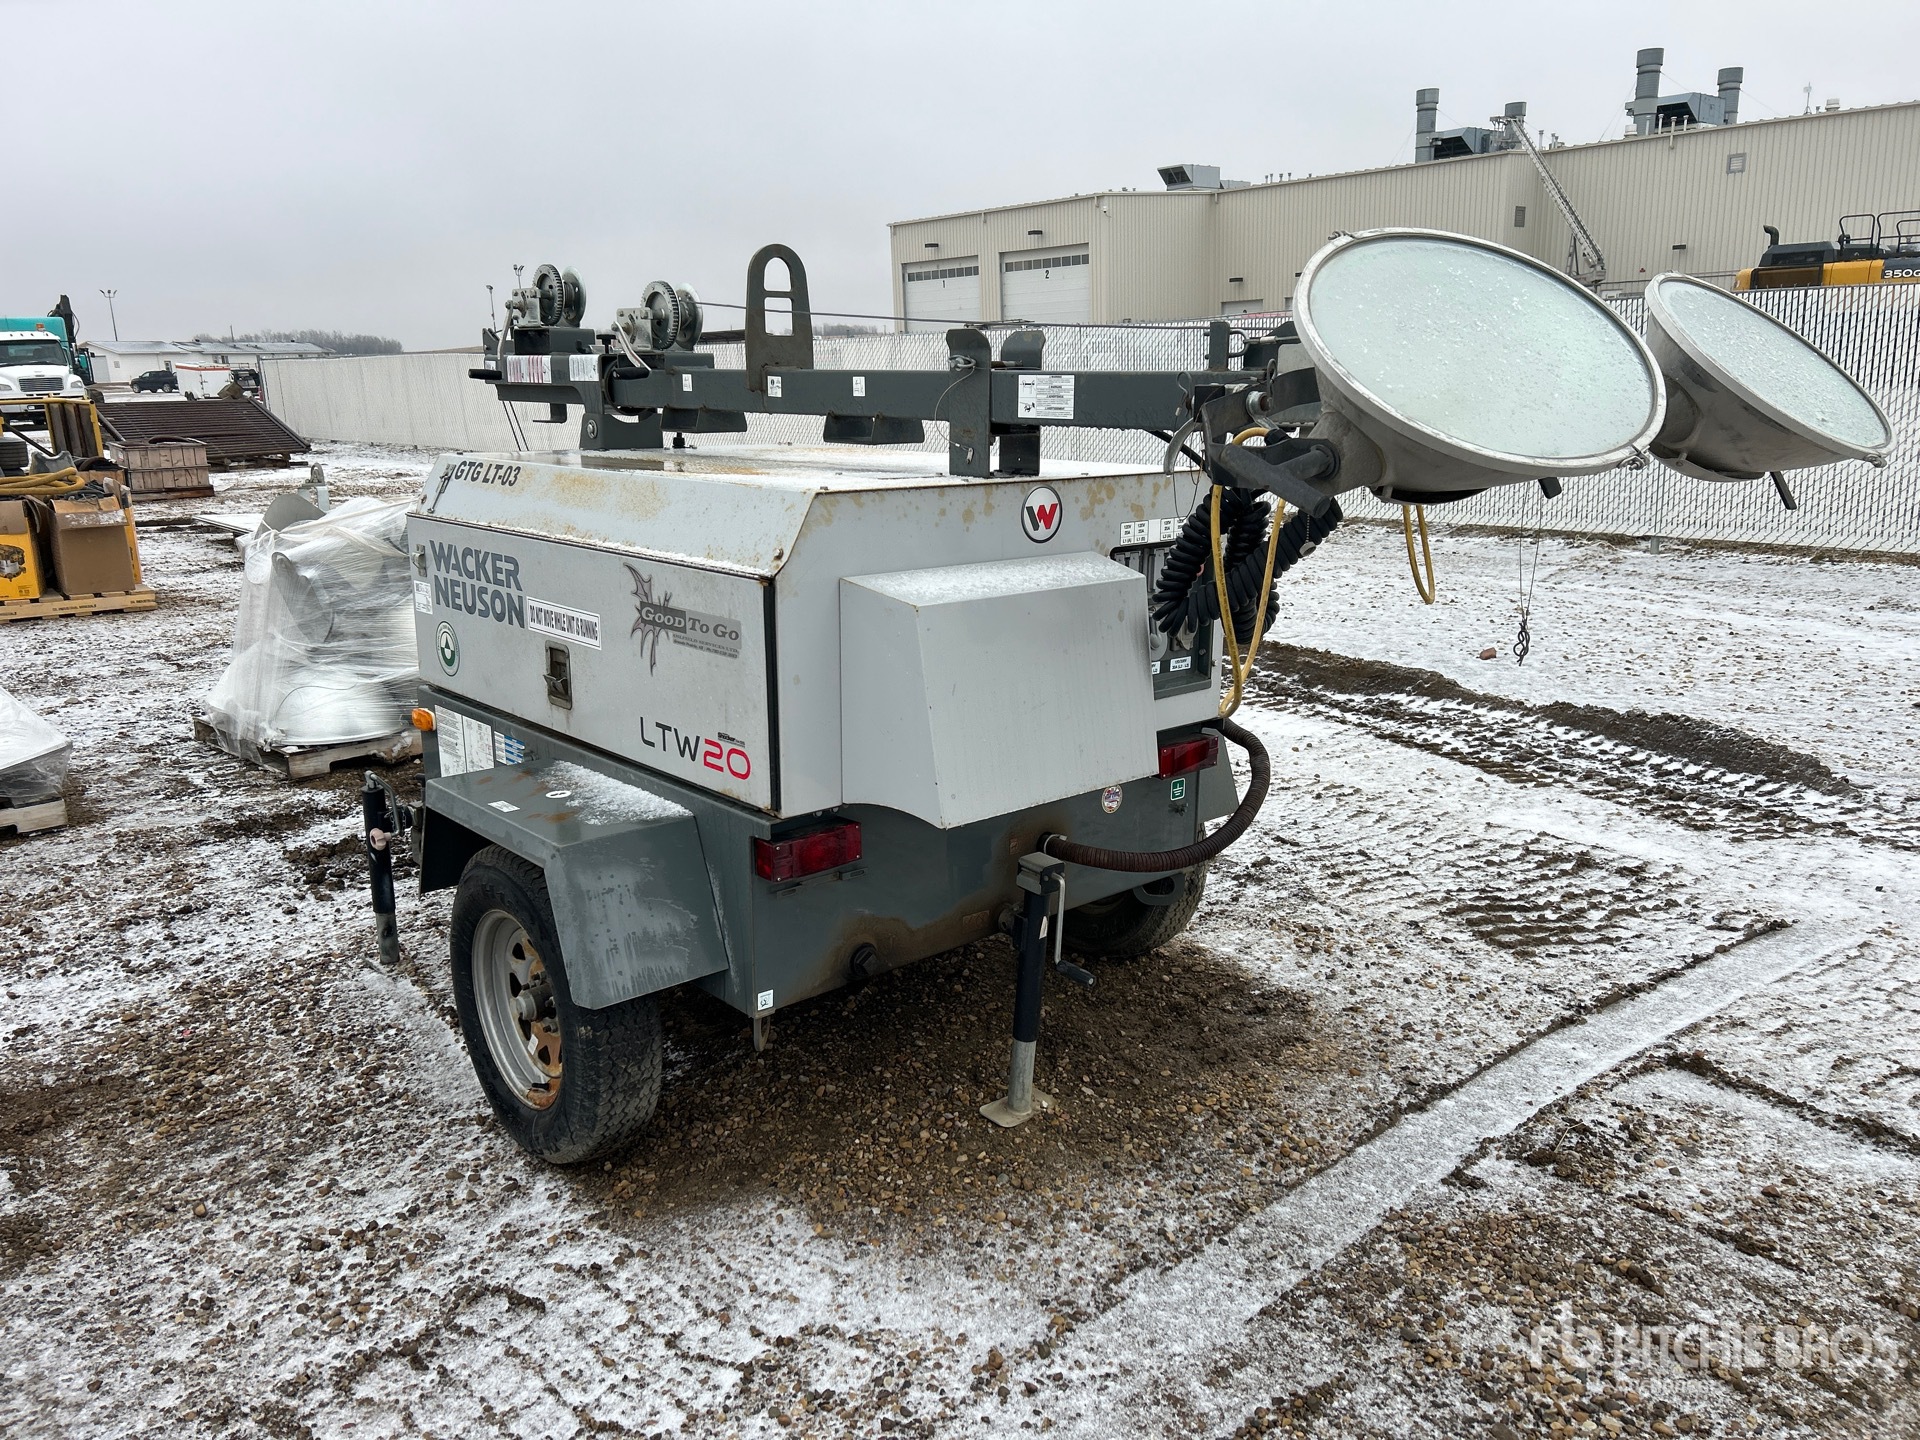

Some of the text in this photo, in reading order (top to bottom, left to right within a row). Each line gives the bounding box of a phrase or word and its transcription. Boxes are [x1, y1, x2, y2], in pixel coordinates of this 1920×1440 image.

[942, 280, 946, 288] 1
[1045, 270, 1050, 279] 2
[454, 460, 522, 487] GTG LT-03
[429, 540, 523, 591] WACKER
[434, 575, 525, 629] NEUSON
[536, 606, 544, 625] NOT
